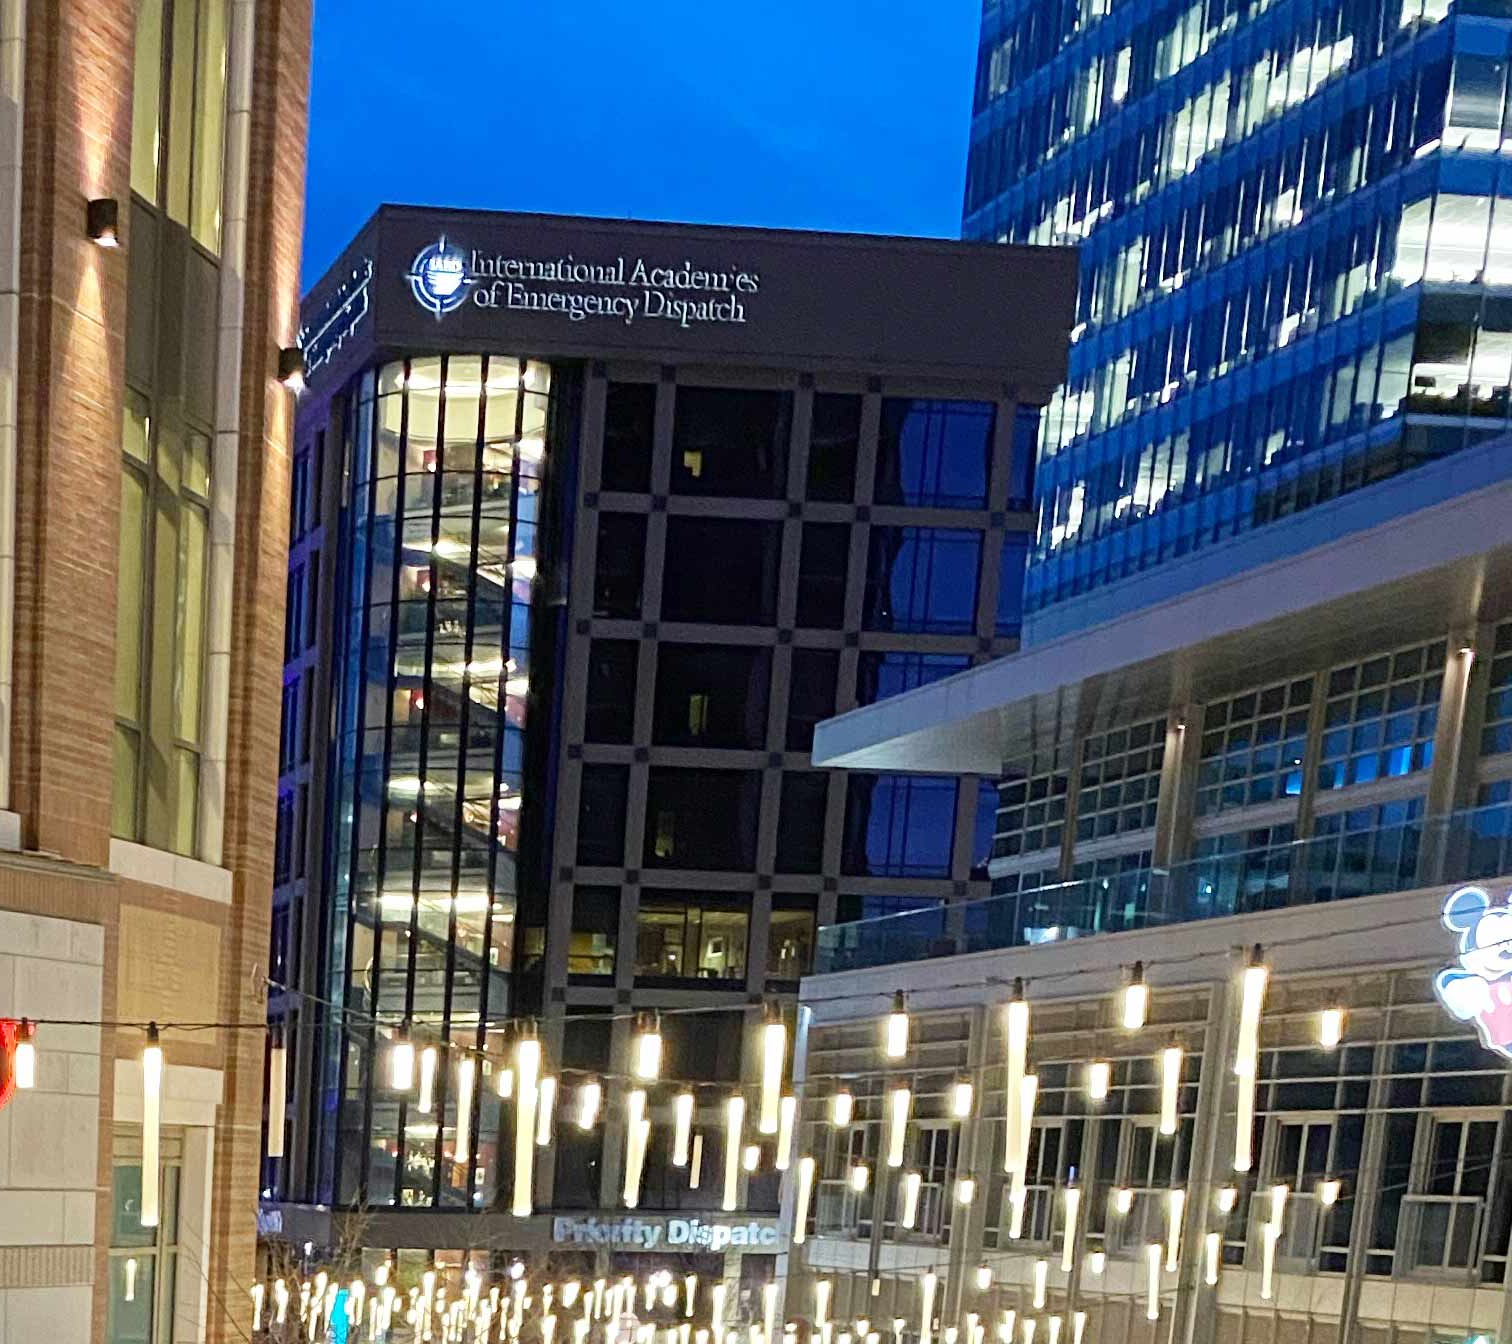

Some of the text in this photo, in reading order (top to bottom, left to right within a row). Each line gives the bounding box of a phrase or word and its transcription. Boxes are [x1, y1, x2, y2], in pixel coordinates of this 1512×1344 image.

[471, 249, 759, 294] International Academies
[473, 281, 747, 328] of Emergency Dispatch
[554, 1217, 777, 1251] Priority Dispatc
